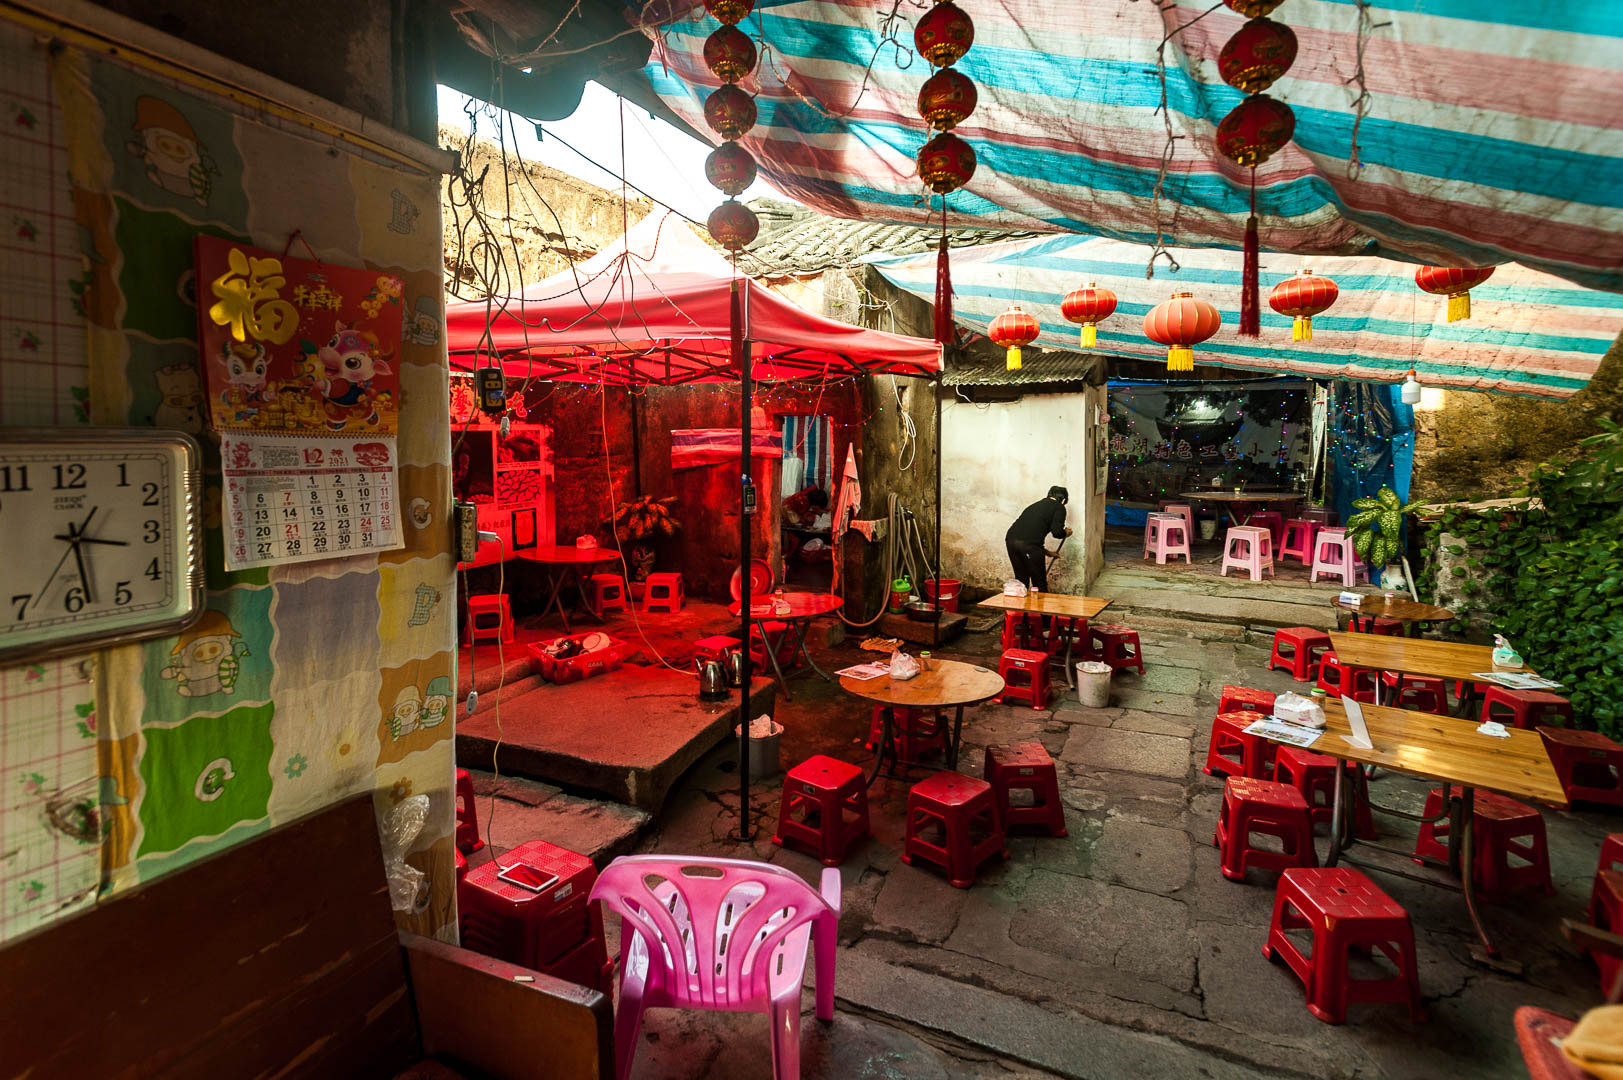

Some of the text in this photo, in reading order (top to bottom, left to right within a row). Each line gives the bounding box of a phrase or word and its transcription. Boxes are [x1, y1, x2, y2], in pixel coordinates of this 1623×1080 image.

[209, 247, 299, 345] 福
[293, 284, 343, 312] 牛年吉祥
[302, 448, 324, 464] 12
[329, 457, 348, 465] 2021
[0, 463, 131, 492] 11 12 1
[309, 476, 315, 484] 1
[334, 475, 341, 483] 2
[359, 474, 365, 482] 3
[141, 482, 159, 506] 2
[233, 495, 239, 503] 5
[258, 494, 264, 503] 6
[284, 493, 291, 501] 7
[311, 492, 318, 500] 8
[336, 490, 343, 498] 9
[357, 488, 370, 497] 10
[233, 512, 243, 521] 12
[255, 511, 268, 519] 13
[283, 508, 297, 517] 14
[310, 507, 324, 515] 15
[336, 505, 348, 513] 16
[360, 503, 370, 511] 17
[380, 502, 389, 510] 18
[143, 519, 161, 544] 3
[256, 527, 270, 536] 20
[285, 524, 299, 534] 21
[312, 522, 326, 531] 22
[338, 520, 350, 528] 23
[360, 518, 372, 526] 24
[380, 516, 390, 524] 25
[235, 546, 246, 556] 26
[257, 543, 272, 553] 27
[287, 540, 300, 550] 28
[314, 538, 326, 546] 29
[338, 535, 350, 544] 30
[362, 533, 373, 541] 31
[144, 556, 162, 581] 4
[11, 580, 133, 621] 7 6 5
